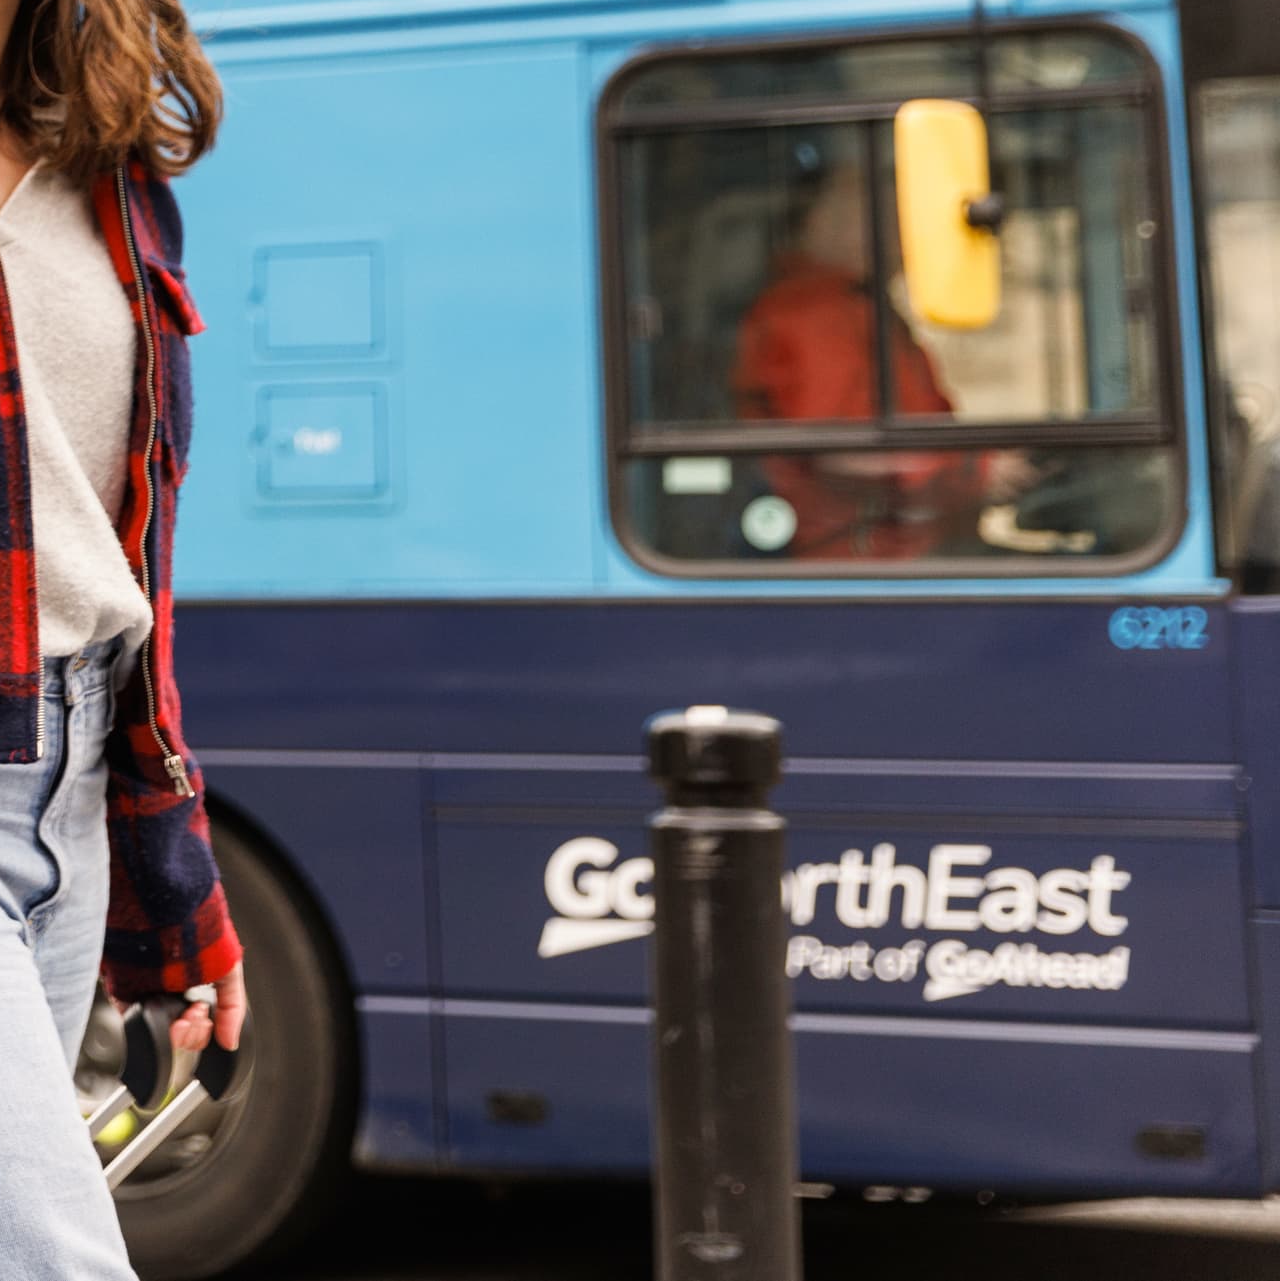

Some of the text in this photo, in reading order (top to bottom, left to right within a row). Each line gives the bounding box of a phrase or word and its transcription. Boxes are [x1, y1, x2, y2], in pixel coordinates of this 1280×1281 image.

[785, 935, 1131, 992] Part of GoAhead
